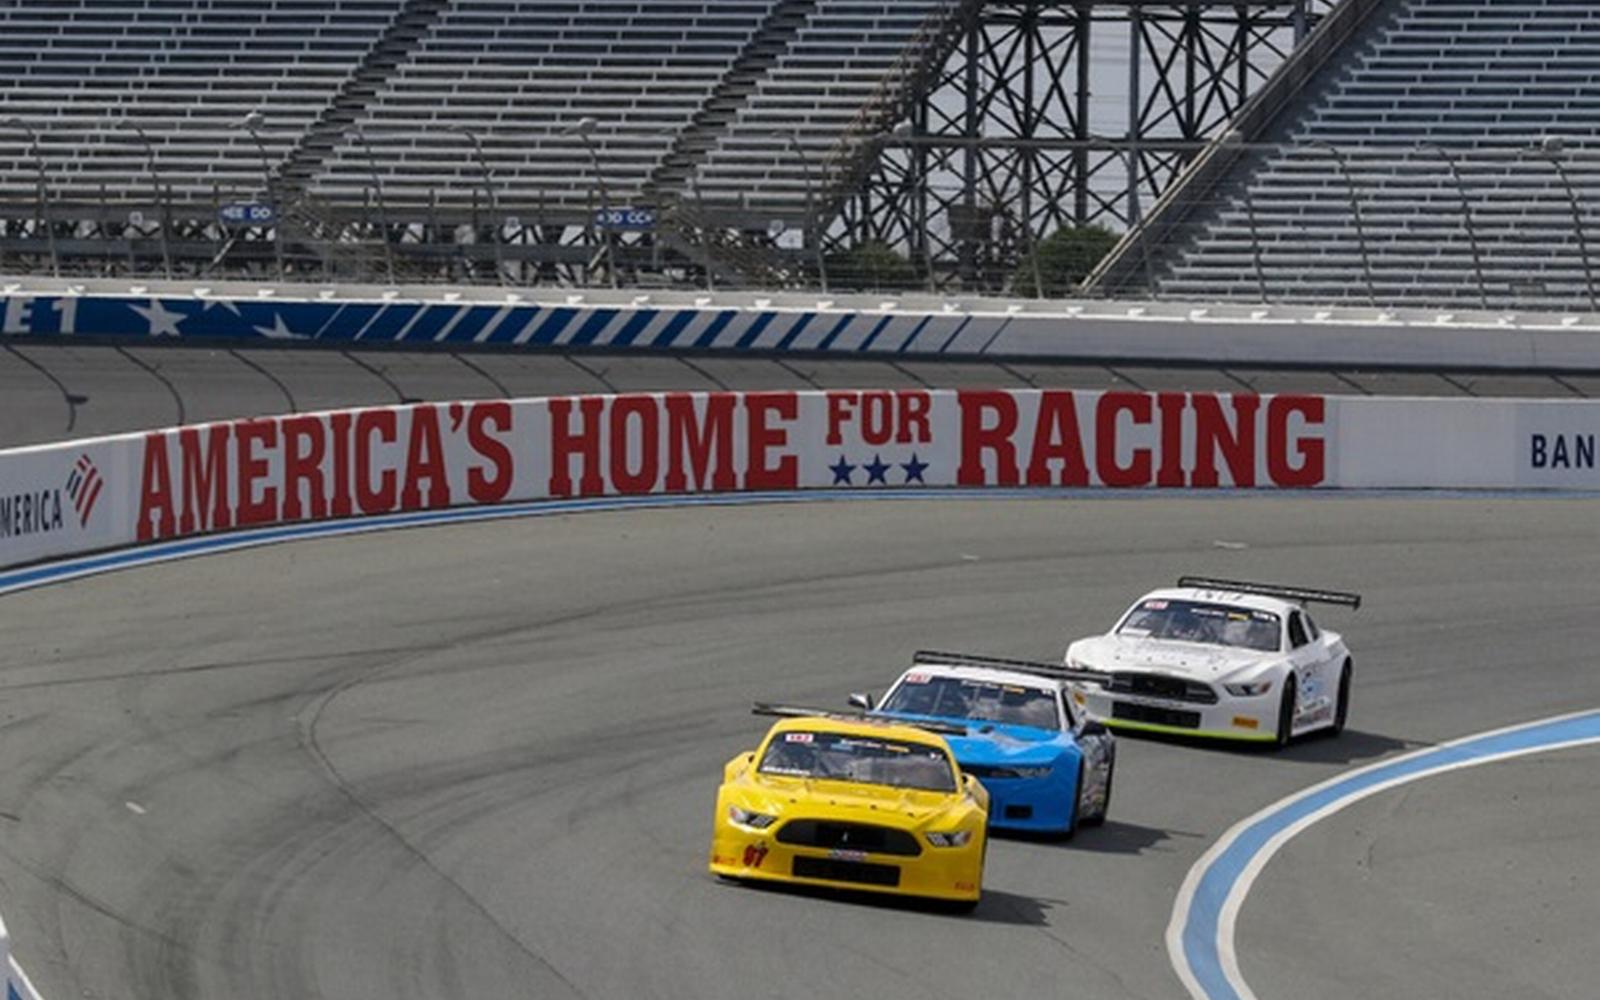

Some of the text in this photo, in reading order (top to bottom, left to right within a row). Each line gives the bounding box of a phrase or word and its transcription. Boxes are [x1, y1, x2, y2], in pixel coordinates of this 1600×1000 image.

[137, 389, 1325, 541] AMERICA'S HOME FOR RACING
[1532, 434, 1594, 468] BAN
